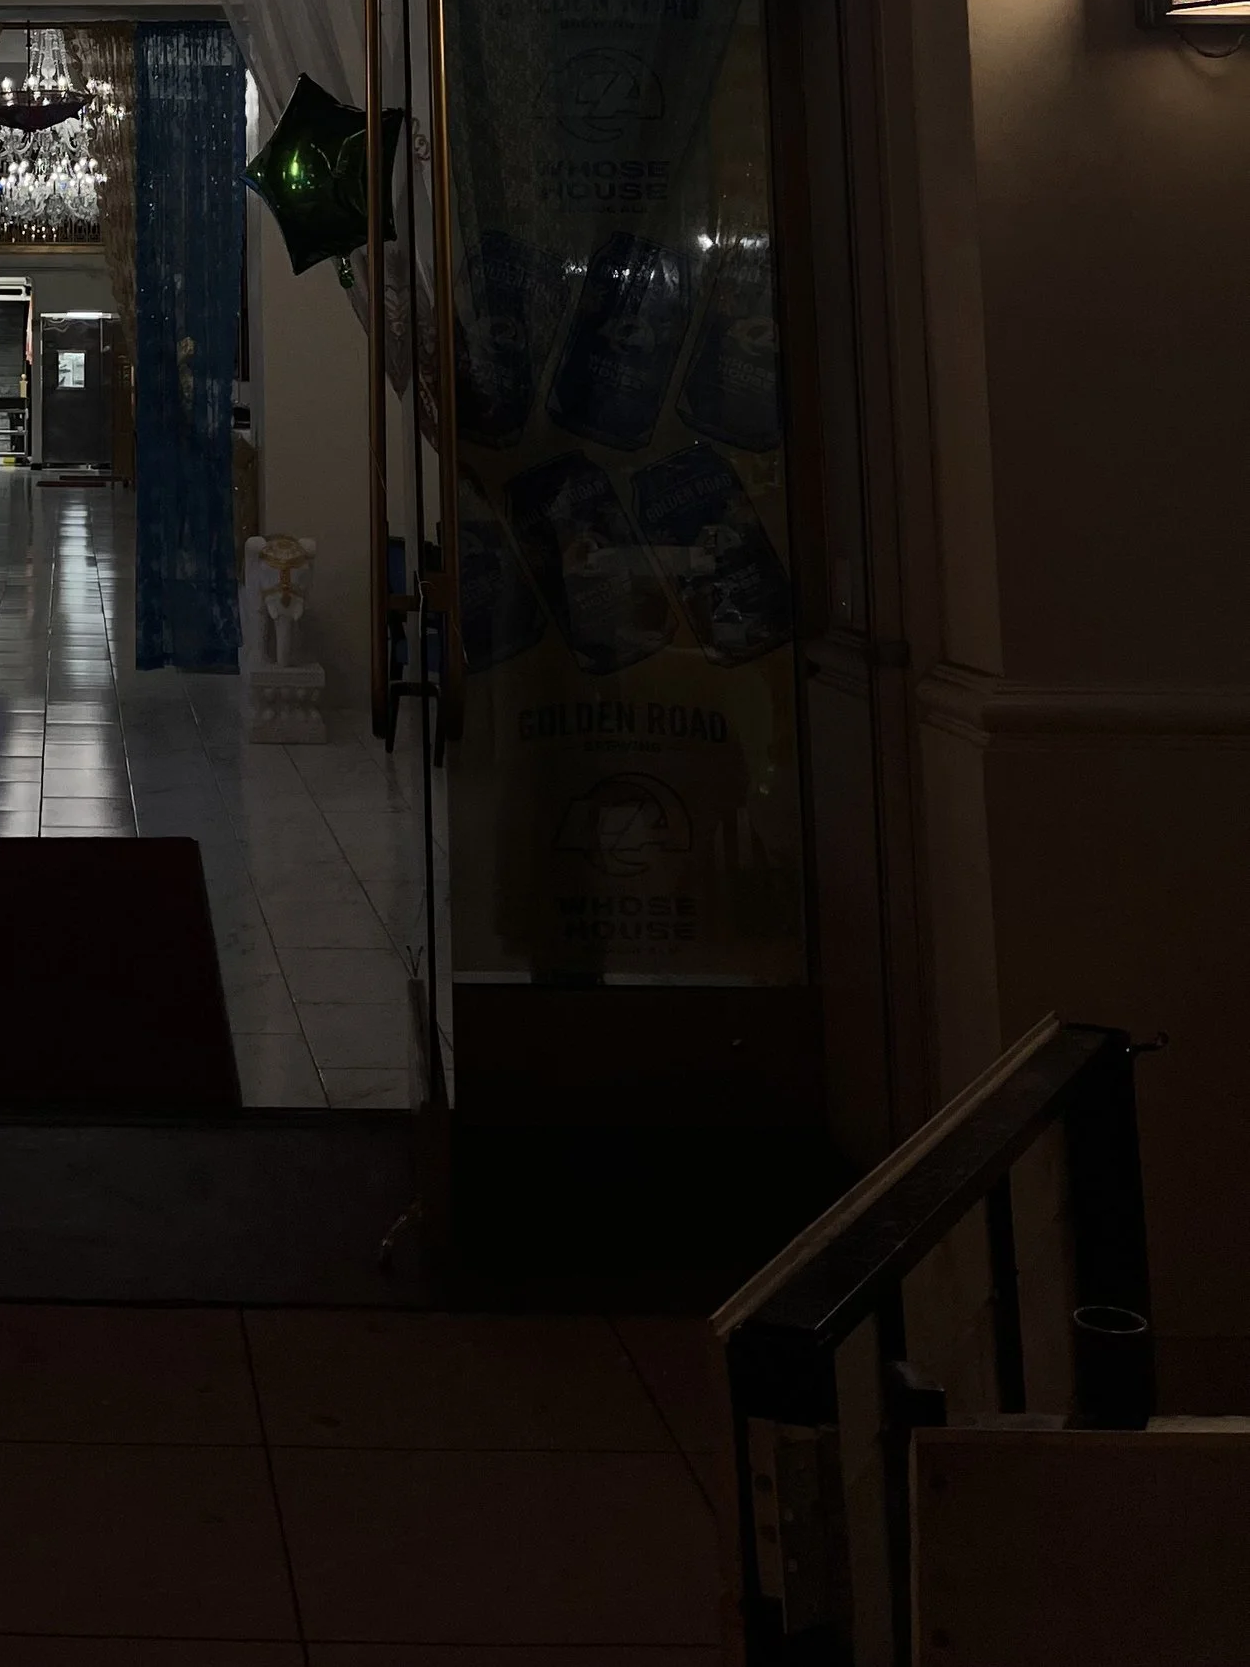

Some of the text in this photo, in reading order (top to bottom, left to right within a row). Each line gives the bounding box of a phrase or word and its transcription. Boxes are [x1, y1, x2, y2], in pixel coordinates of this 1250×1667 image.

[518, 700, 728, 744] GOLDEN ROAD
[555, 896, 697, 916] WHOSE
[563, 919, 697, 940] HOUSE
